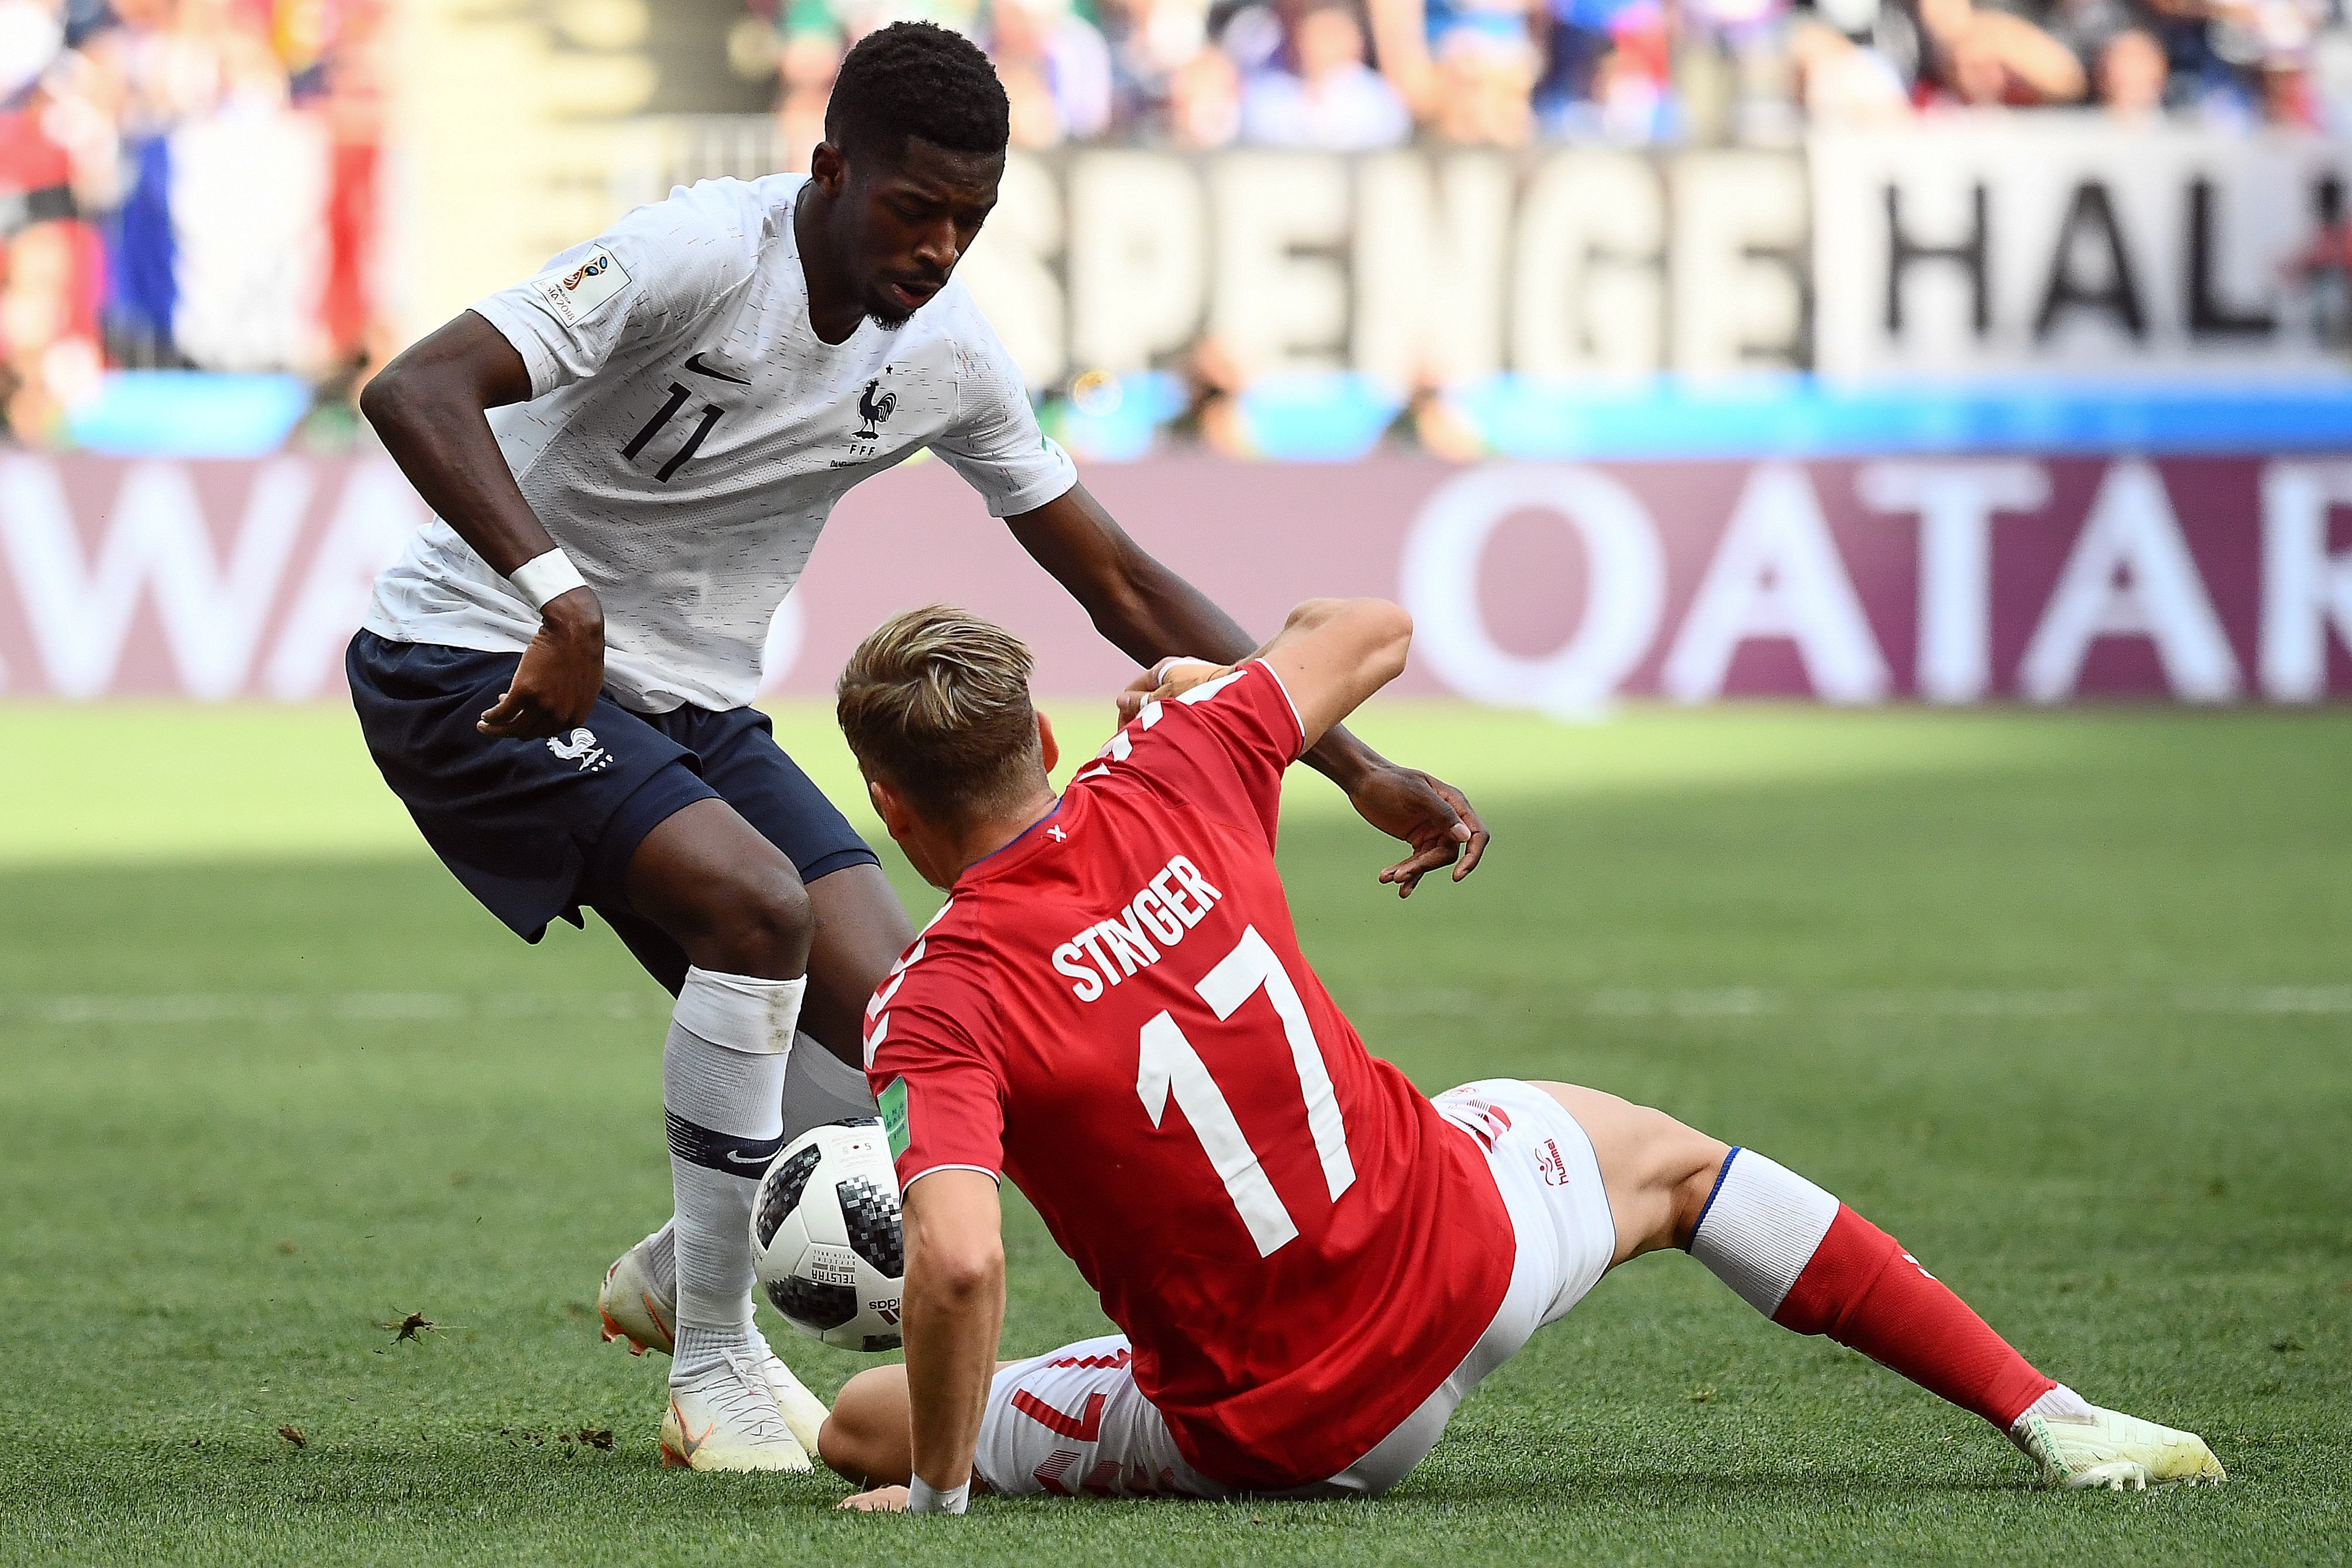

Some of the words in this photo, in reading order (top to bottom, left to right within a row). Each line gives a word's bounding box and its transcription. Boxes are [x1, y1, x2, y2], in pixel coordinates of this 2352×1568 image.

[1879, 174, 2347, 338] HAL
[556, 299, 575, 321] 2018
[621, 381, 726, 484] 11
[1136, 923, 1356, 1258] 17
[1543, 1139, 1570, 1186] hummel
[811, 1269, 855, 1284] TELSTAR
[868, 1298, 900, 1310] idas
